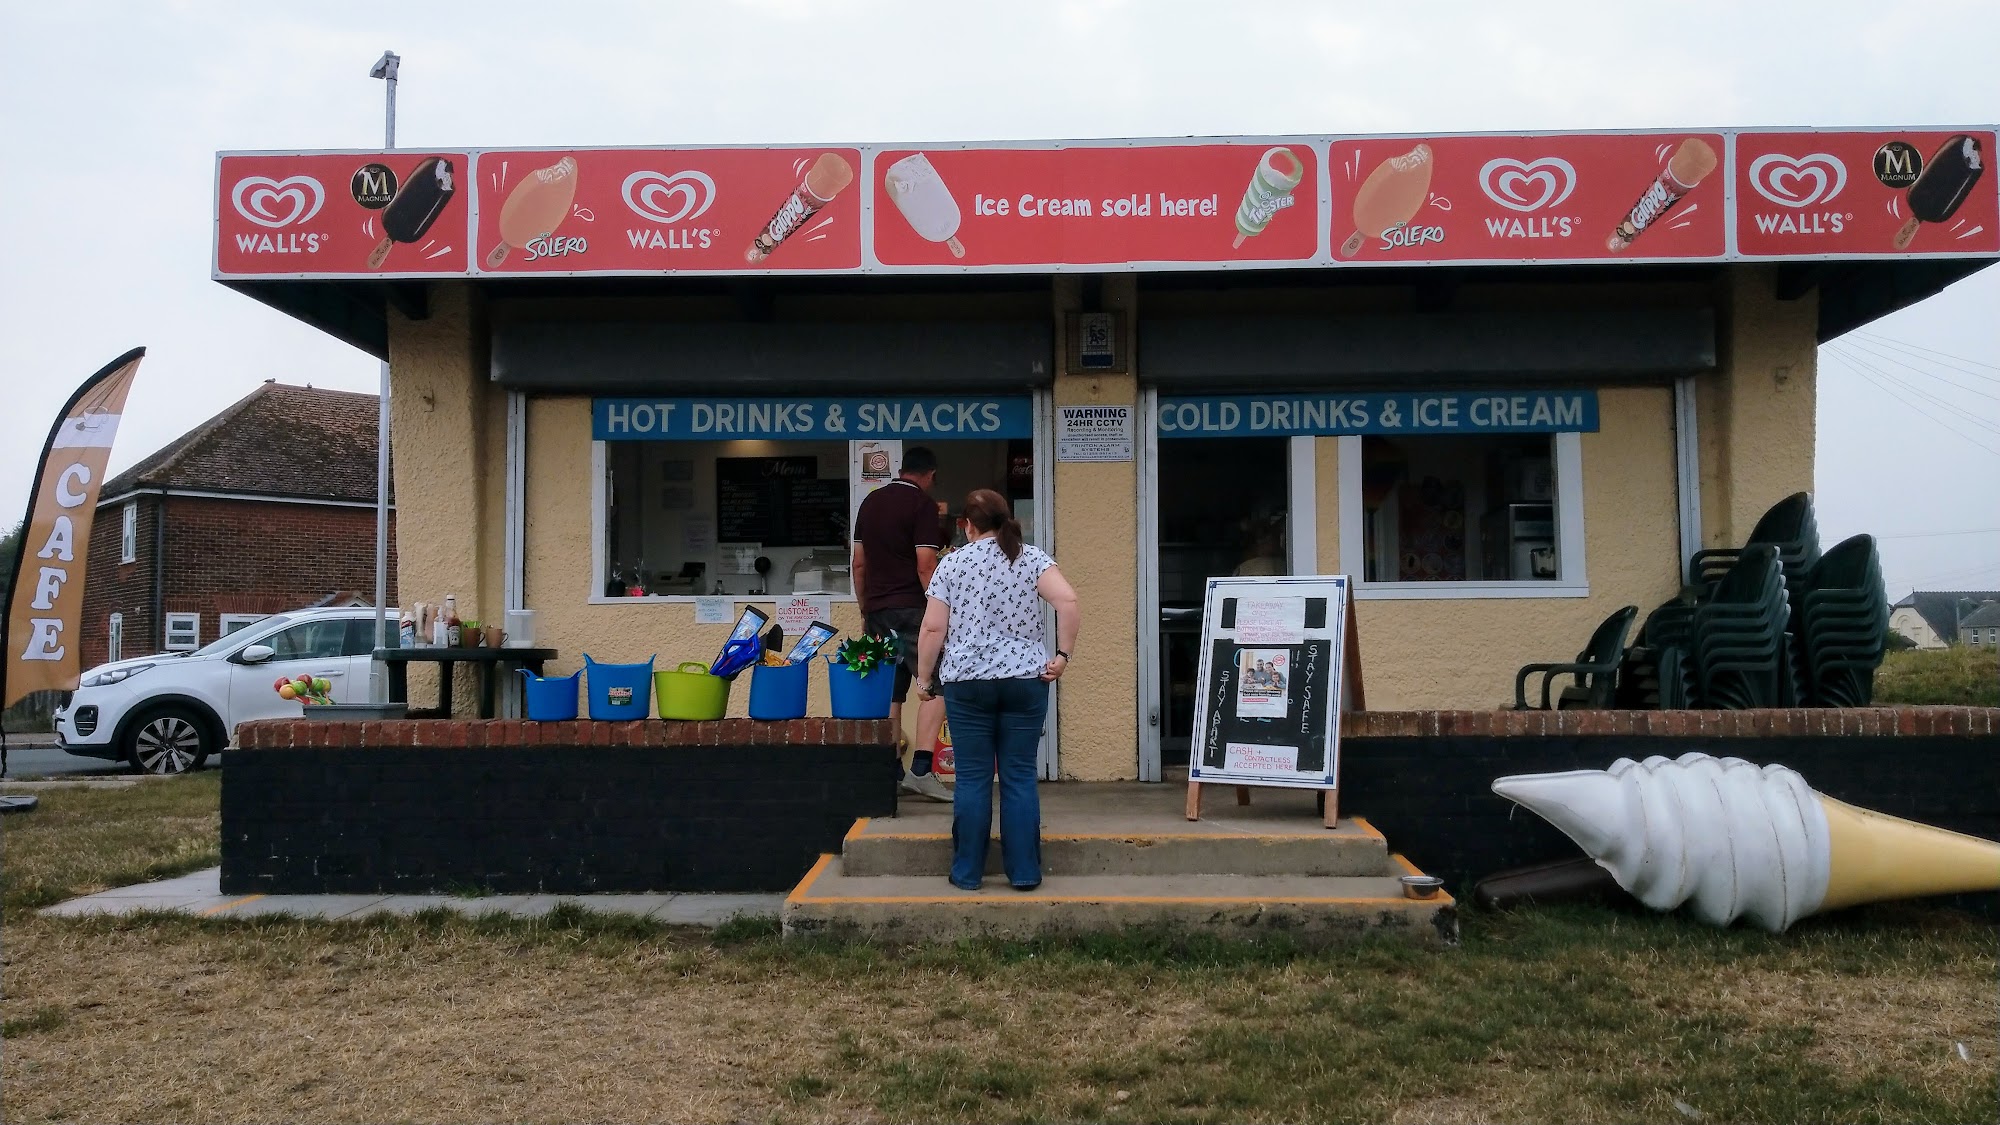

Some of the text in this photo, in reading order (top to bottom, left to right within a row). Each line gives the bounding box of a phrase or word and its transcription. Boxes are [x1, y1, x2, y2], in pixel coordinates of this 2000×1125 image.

[1884, 150, 1912, 174] M
[361, 171, 389, 196] M
[975, 192, 1218, 217] Ice Cream sold here!
[1631, 180, 1668, 230] Calippo
[770, 193, 804, 242] Calippo
[1485, 216, 1572, 238] WALL'S
[1755, 212, 1844, 234] WALL'S
[236, 233, 320, 254] WALL'S
[524, 236, 588, 262] SOLERO
[626, 228, 711, 250] WALL'S
[1380, 225, 1445, 251] SOLERO
[608, 402, 1000, 432] HOT DRINKS & SNACKS
[1064, 409, 1127, 418] WARNING
[1158, 396, 1582, 432] COLD DRINKS & ICE CREAM
[21, 462, 91, 661] CAFE
[778, 607, 820, 615] CUSTOMER
[791, 598, 810, 607] ONE
[1245, 601, 1284, 609] TAKEAWAY
[1300, 644, 1318, 734] STAY SAFE
[1209, 670, 1230, 758] STAY APART
[1229, 746, 1253, 755] CASH
[1244, 755, 1291, 763] CONTACTLESS
